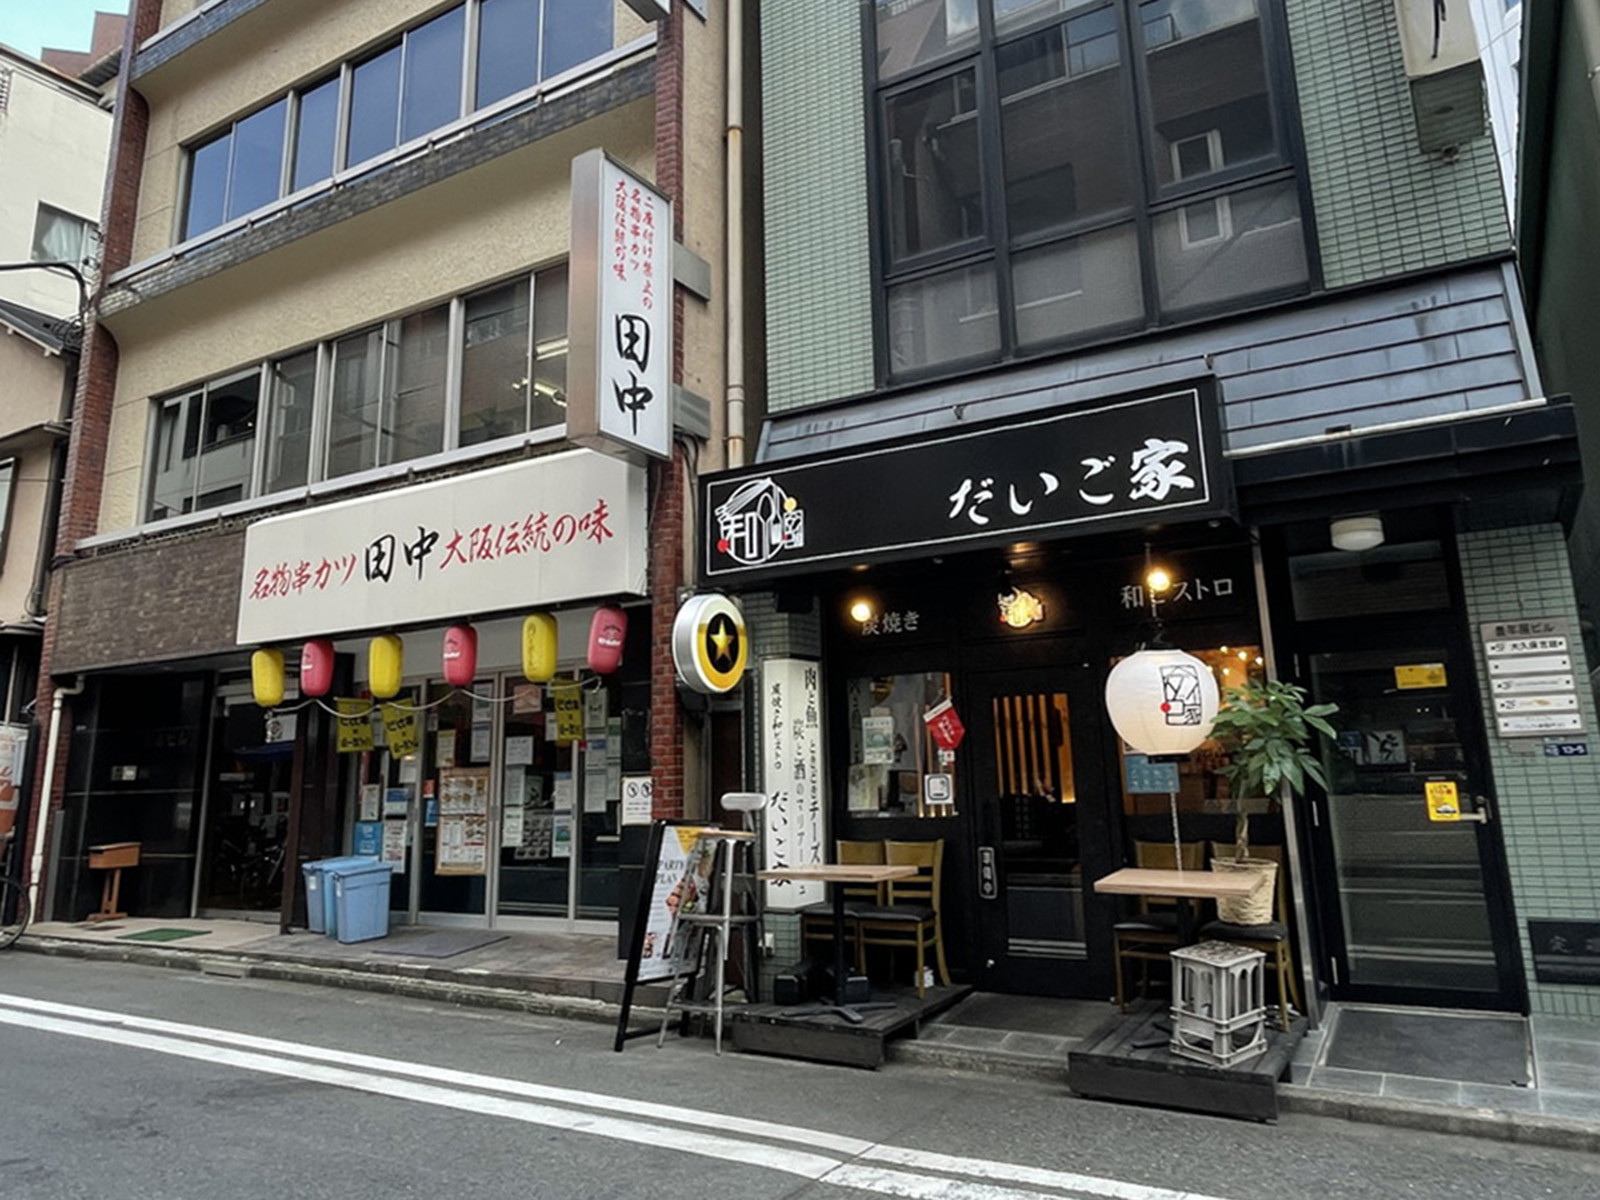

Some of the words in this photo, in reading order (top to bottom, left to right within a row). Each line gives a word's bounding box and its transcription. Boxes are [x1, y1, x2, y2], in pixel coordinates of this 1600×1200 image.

[630, 187, 642, 271] 名物串カツ
[612, 313, 654, 436] 田中
[948, 438, 1195, 526] だいご家
[248, 553, 357, 600] 名物串カツ
[364, 526, 440, 583] 田中
[440, 499, 614, 570] 大阪伝統の味
